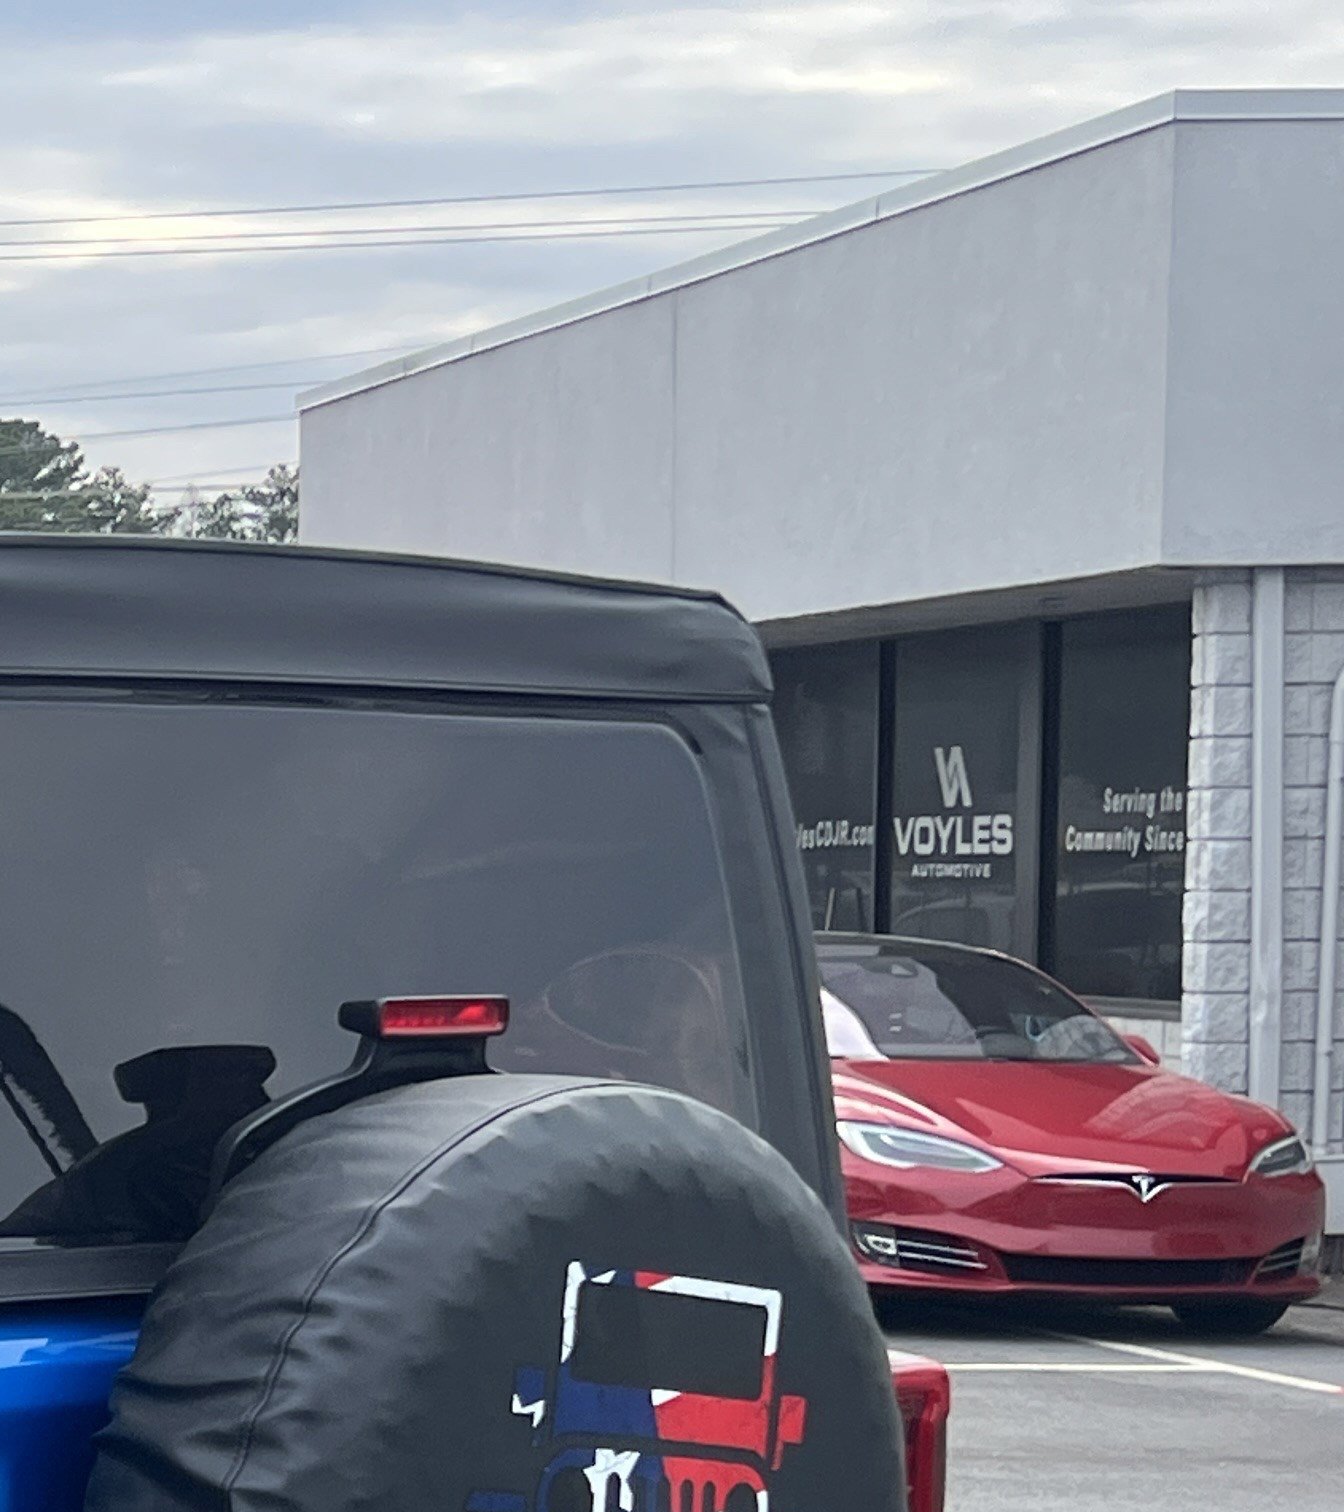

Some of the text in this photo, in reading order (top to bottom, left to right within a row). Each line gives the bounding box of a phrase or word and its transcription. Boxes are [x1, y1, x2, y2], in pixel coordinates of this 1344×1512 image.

[1103, 786, 1183, 819] Serving the
[893, 814, 1013, 856] VOYLES
[1065, 824, 1184, 858] Community Since
[911, 863, 991, 878] AUTOMOTIVE
